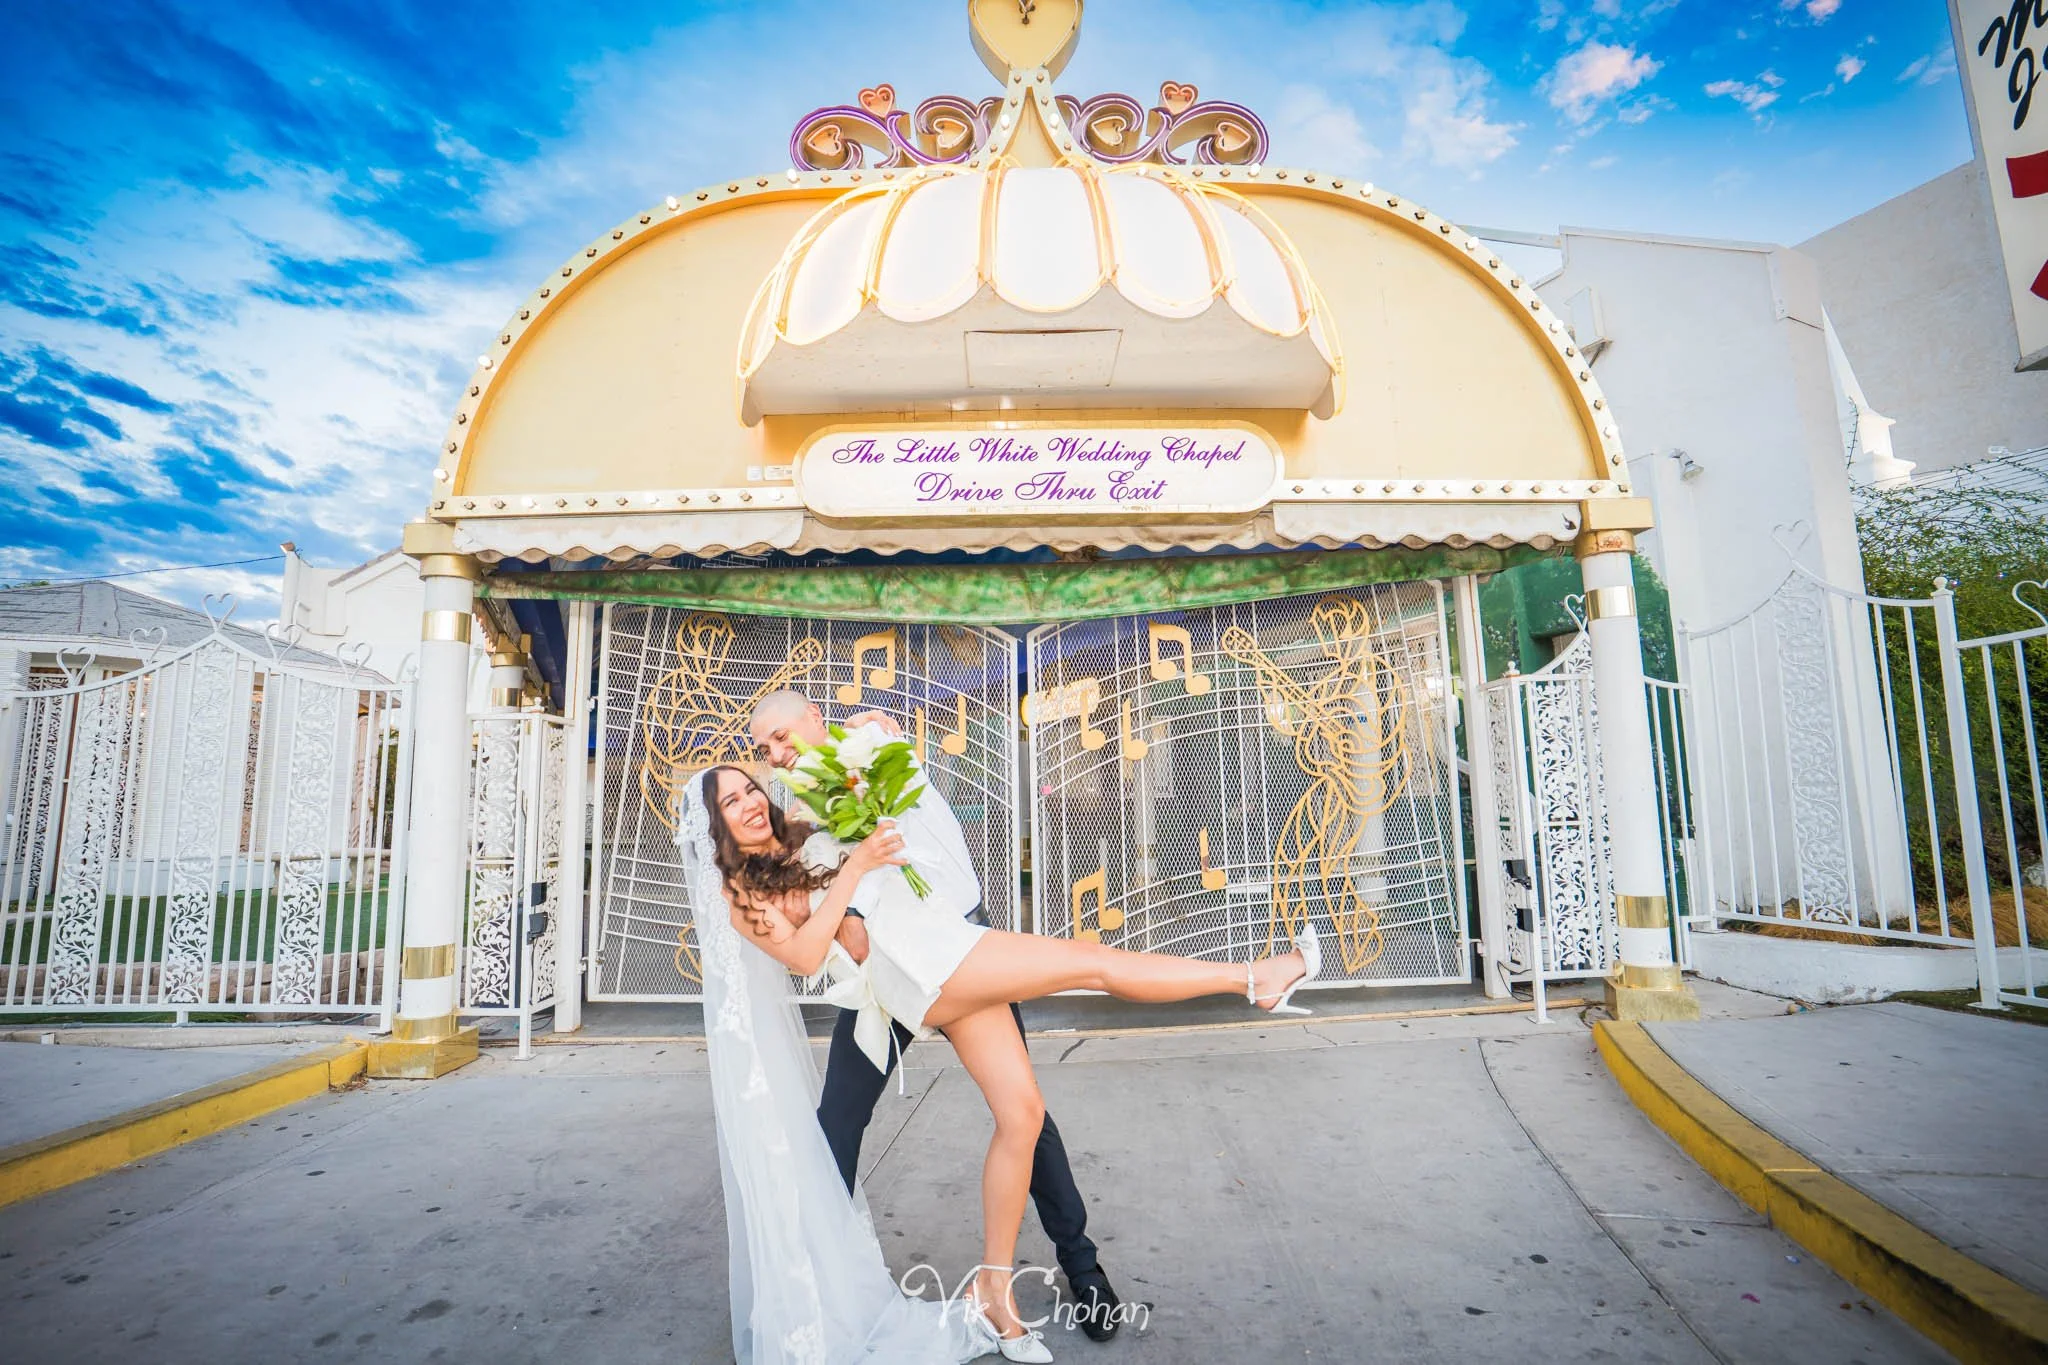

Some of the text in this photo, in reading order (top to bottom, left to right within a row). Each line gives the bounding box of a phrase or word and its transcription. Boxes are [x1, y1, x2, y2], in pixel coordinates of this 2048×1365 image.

[832, 436, 1246, 470] The Little White Wedding Chapel
[914, 470, 1168, 503] Drive Thru Exit
